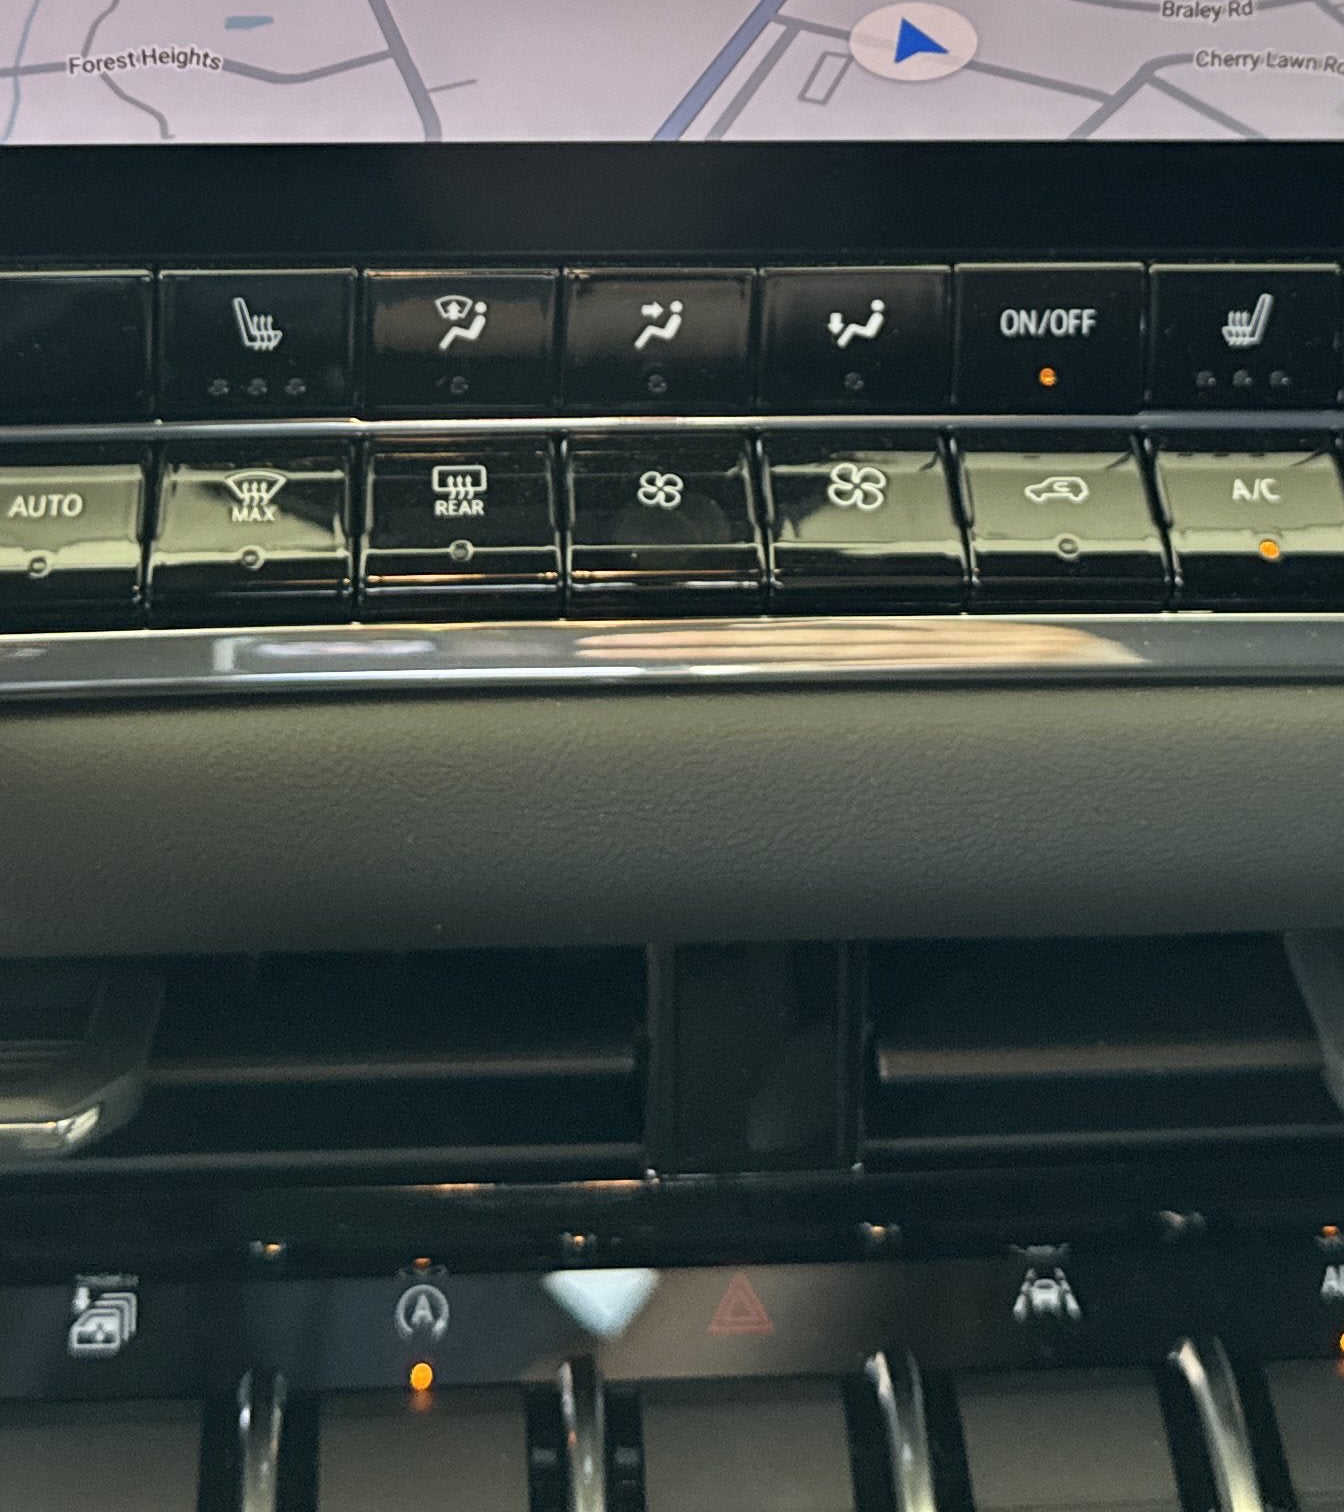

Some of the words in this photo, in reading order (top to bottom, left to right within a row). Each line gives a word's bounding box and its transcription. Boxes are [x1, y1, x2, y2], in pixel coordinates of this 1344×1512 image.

[1162, 0, 1220, 22] Braley
[69, 52, 136, 75] Forest
[142, 48, 222, 74] Heights
[1194, 50, 1262, 74] Cherry
[1266, 52, 1316, 73] Lawn
[1000, 308, 1096, 337] ON/OFF
[1231, 478, 1281, 502] A/C
[8, 493, 84, 519] AUTO
[230, 505, 278, 523] MAX
[434, 499, 485, 517] REAR
